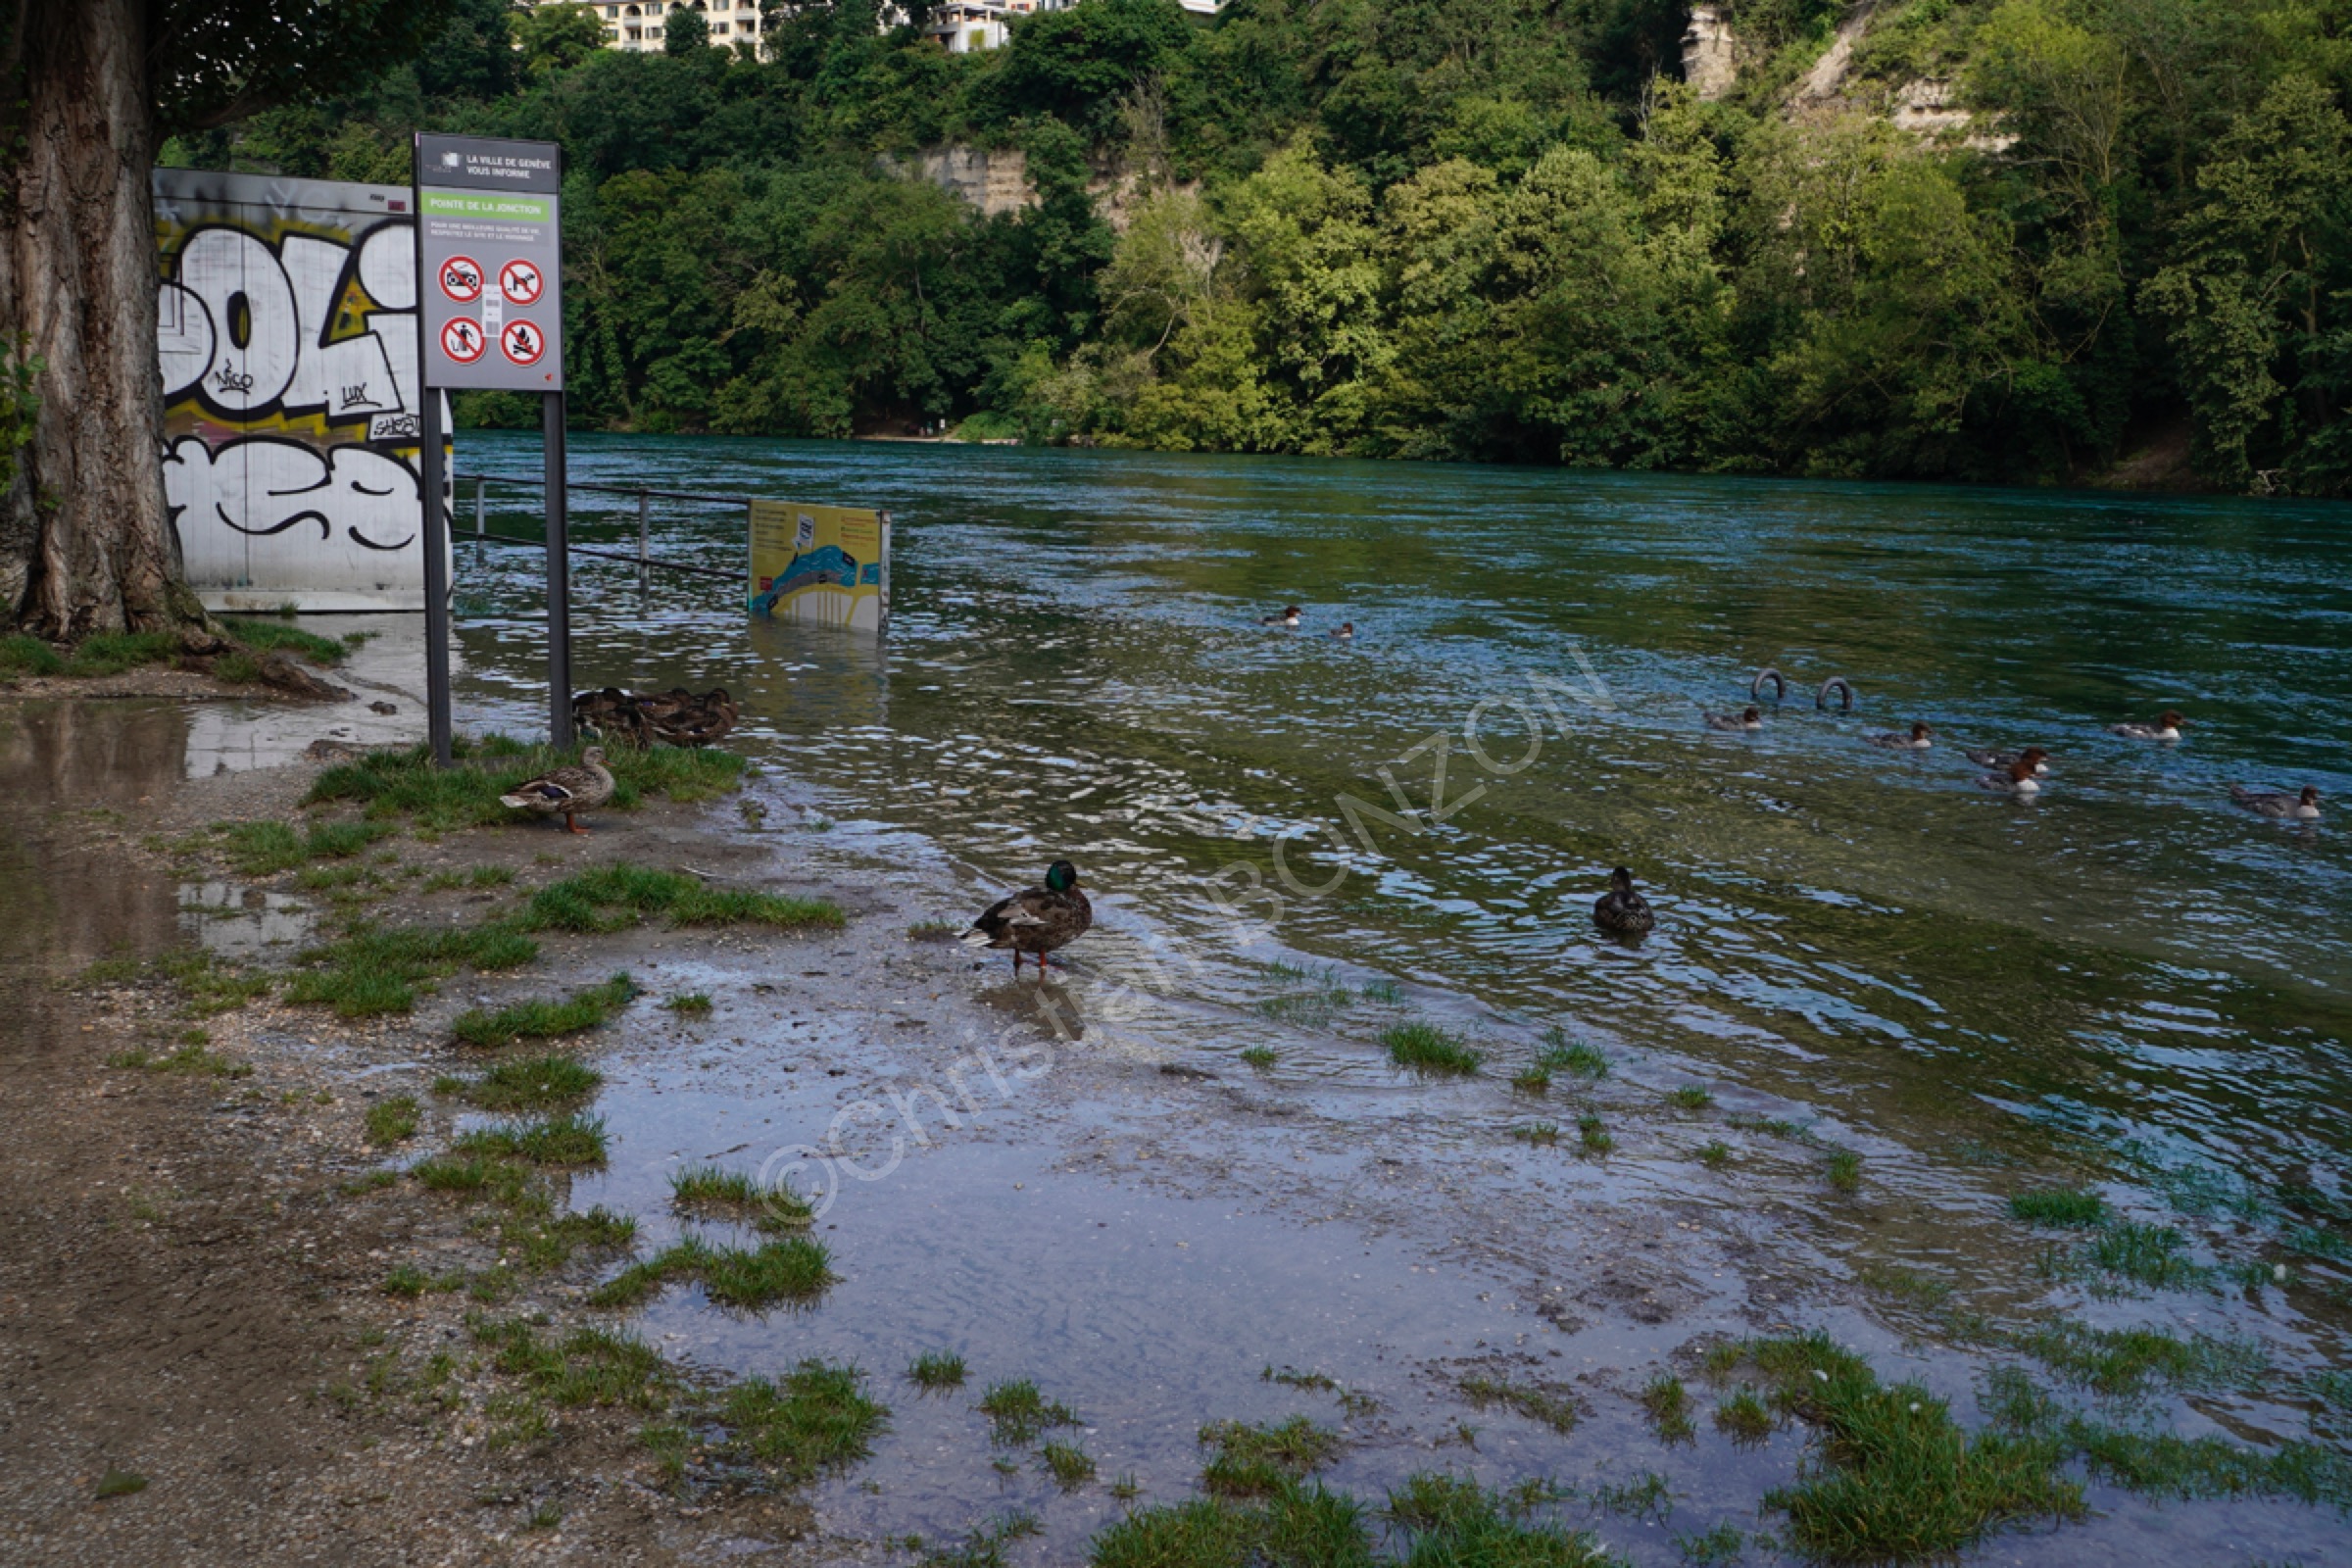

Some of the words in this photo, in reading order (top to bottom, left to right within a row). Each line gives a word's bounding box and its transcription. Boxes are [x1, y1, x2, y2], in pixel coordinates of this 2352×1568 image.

[466, 154, 477, 164] LA
[479, 155, 503, 166] VILLE
[505, 158, 515, 168] DE
[518, 158, 551, 170] GENÈVE
[466, 166, 490, 175] VOUS
[491, 168, 531, 179] INFORME
[430, 198, 465, 211] POINTE
[466, 201, 479, 211] DE
[481, 202, 494, 212] LA
[496, 203, 542, 215] JONCTION
